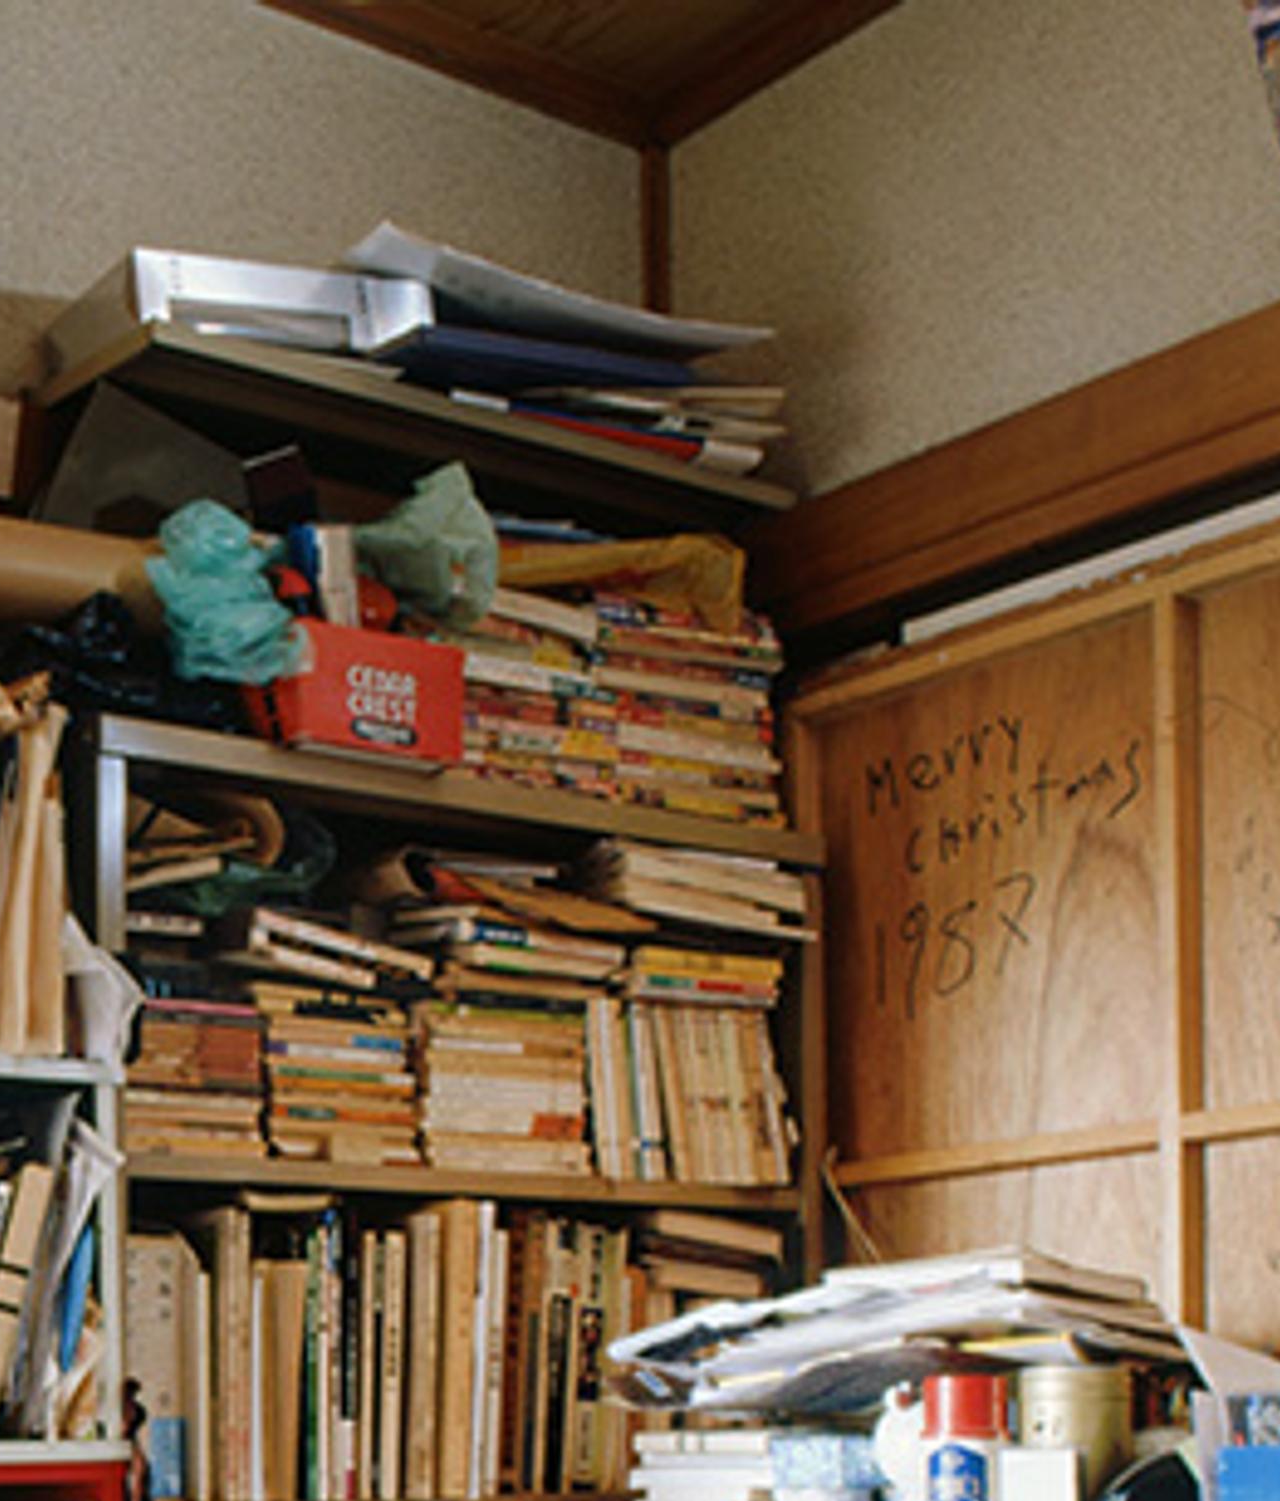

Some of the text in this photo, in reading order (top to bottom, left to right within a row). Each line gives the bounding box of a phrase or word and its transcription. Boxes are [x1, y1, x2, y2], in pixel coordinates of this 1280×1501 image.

[346, 664, 417, 696] CEDAR
[346, 692, 417, 725] CREST
[865, 716, 1022, 817] Merry
[876, 872, 1037, 1019] 1987
